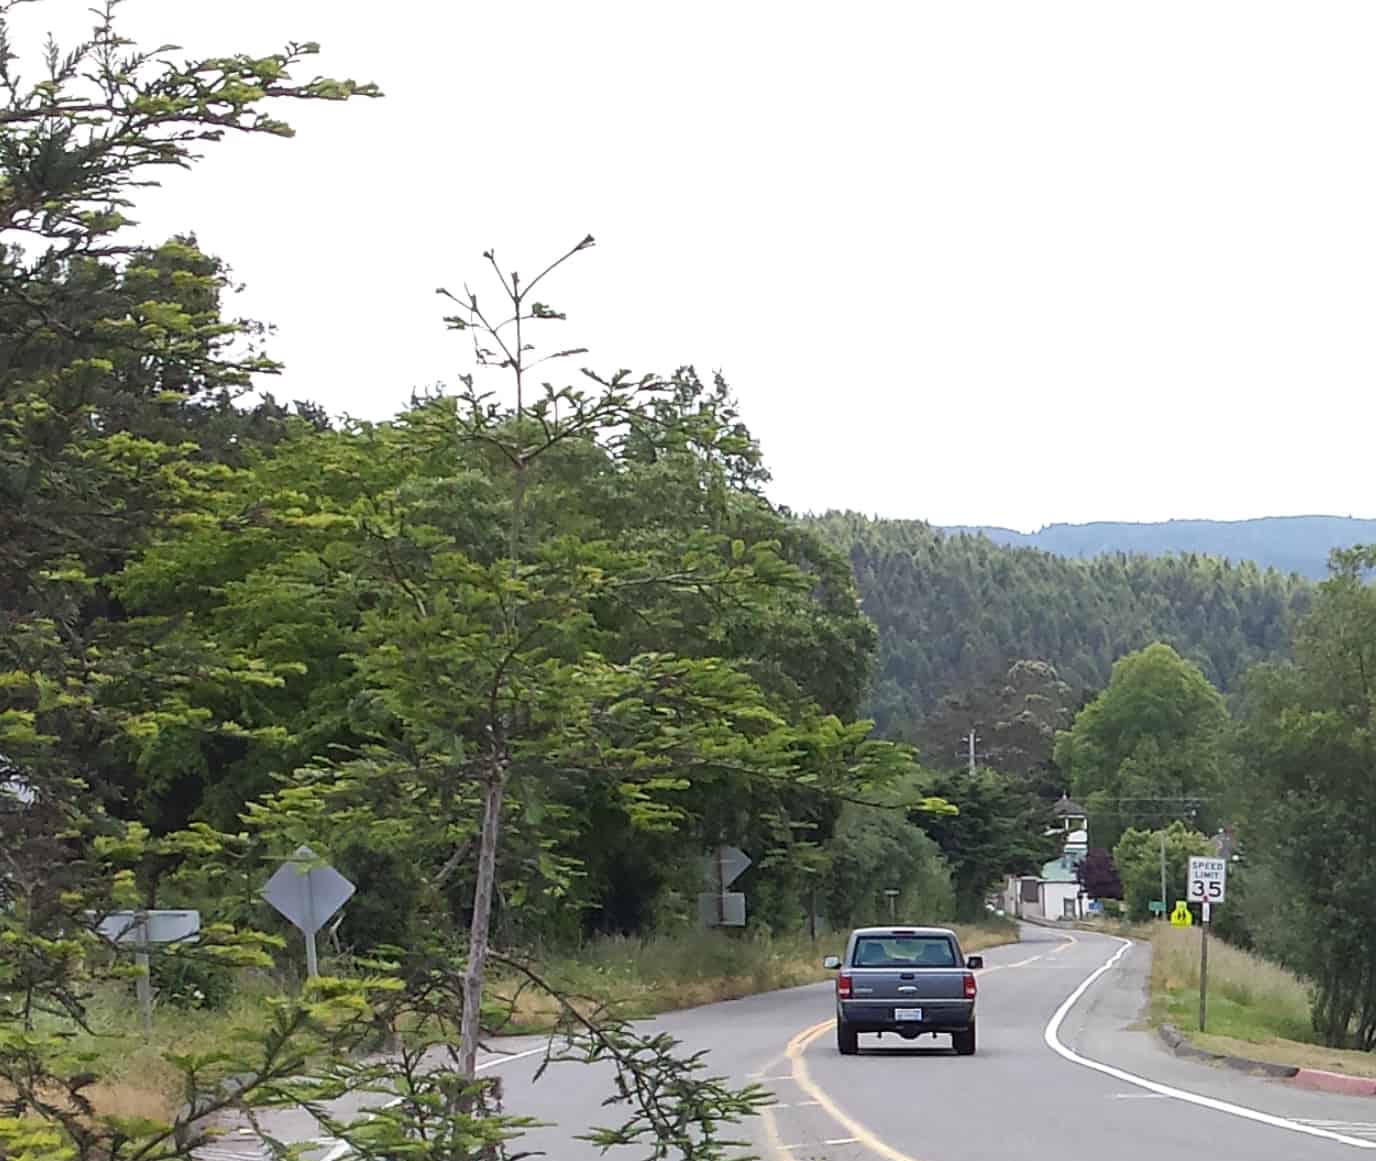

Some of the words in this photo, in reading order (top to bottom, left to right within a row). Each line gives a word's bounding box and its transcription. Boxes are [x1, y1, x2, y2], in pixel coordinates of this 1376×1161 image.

[1192, 862, 1223, 871] SPEED
[1194, 871, 1219, 879] LIMIT
[1192, 880, 1221, 897] 35
